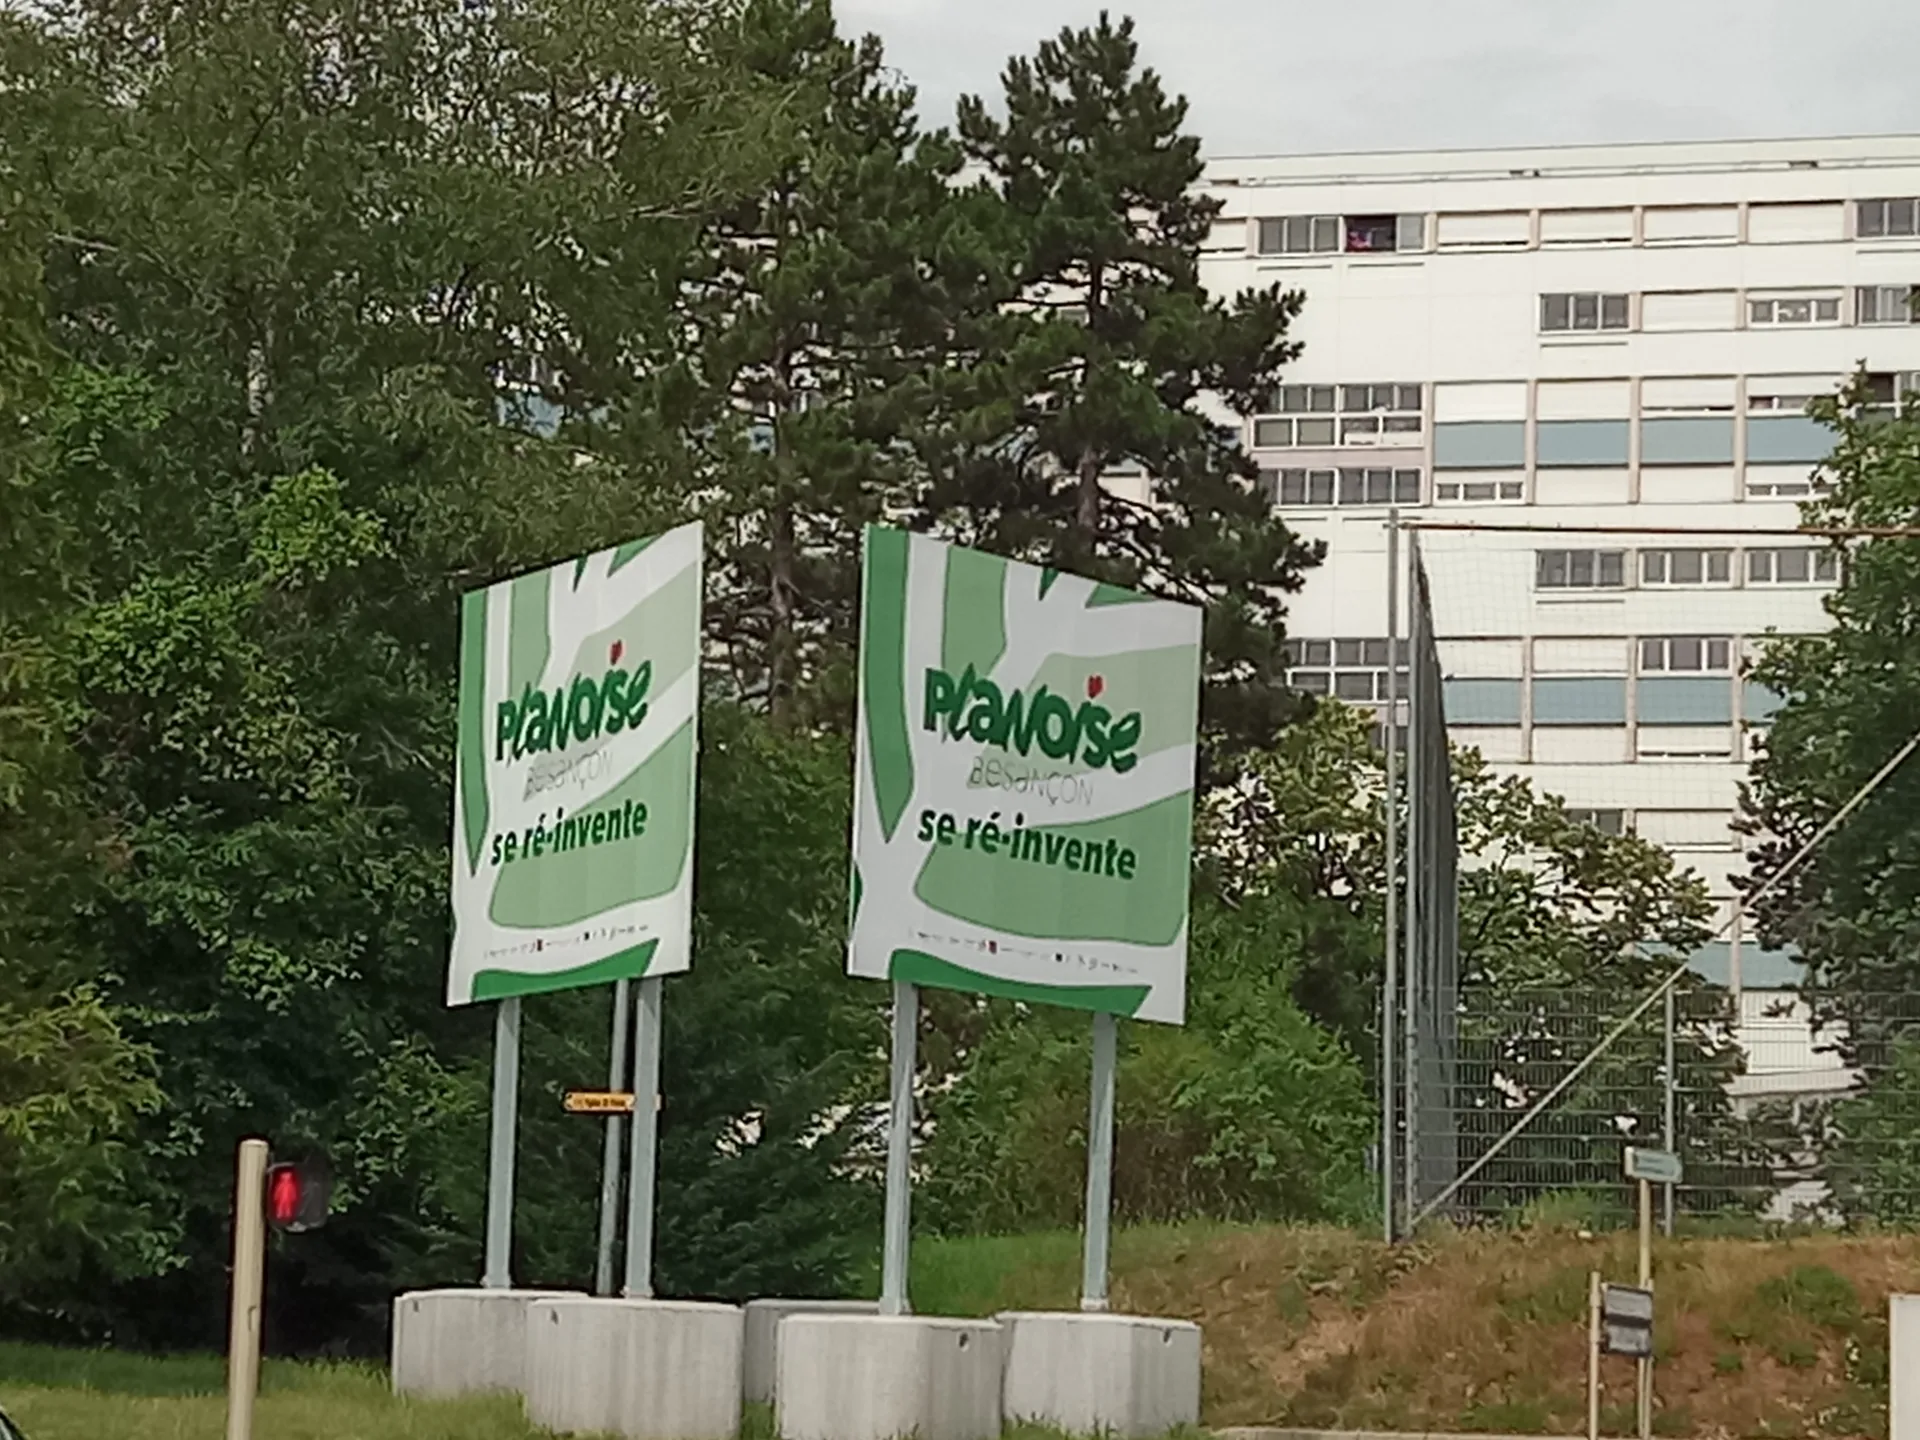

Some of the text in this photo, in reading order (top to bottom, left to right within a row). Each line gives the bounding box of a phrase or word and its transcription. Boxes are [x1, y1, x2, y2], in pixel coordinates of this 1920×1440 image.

[491, 799, 649, 866] se ré-invente
[918, 809, 1137, 880] se ré-invente
